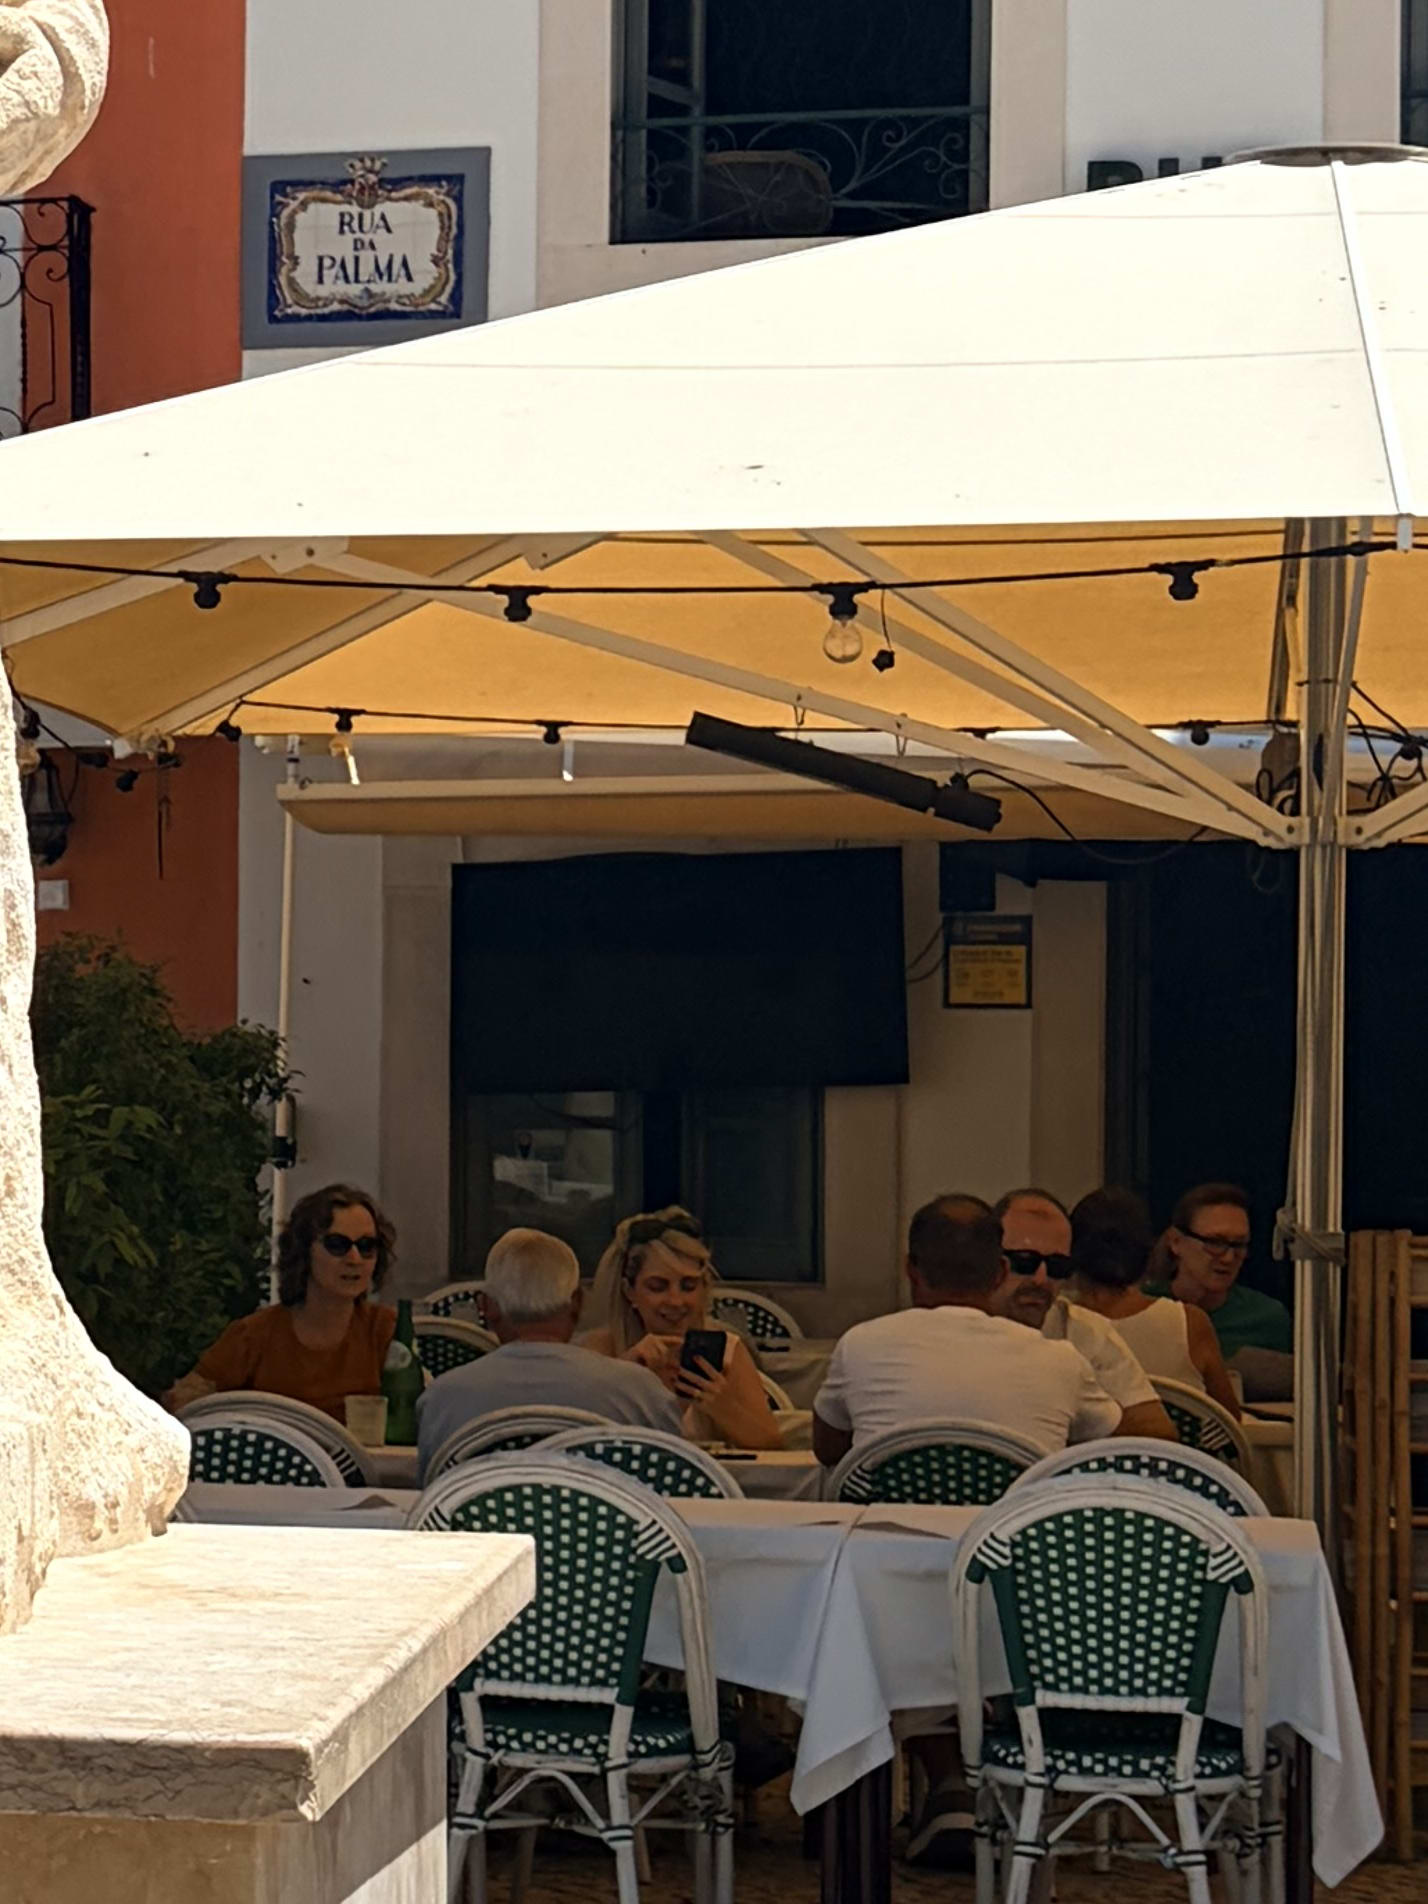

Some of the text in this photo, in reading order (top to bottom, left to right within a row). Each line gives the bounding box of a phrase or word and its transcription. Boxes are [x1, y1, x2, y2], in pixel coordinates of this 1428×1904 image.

[338, 211, 393, 236] RUA
[352, 238, 377, 252] DA
[316, 254, 414, 286] PALMA
